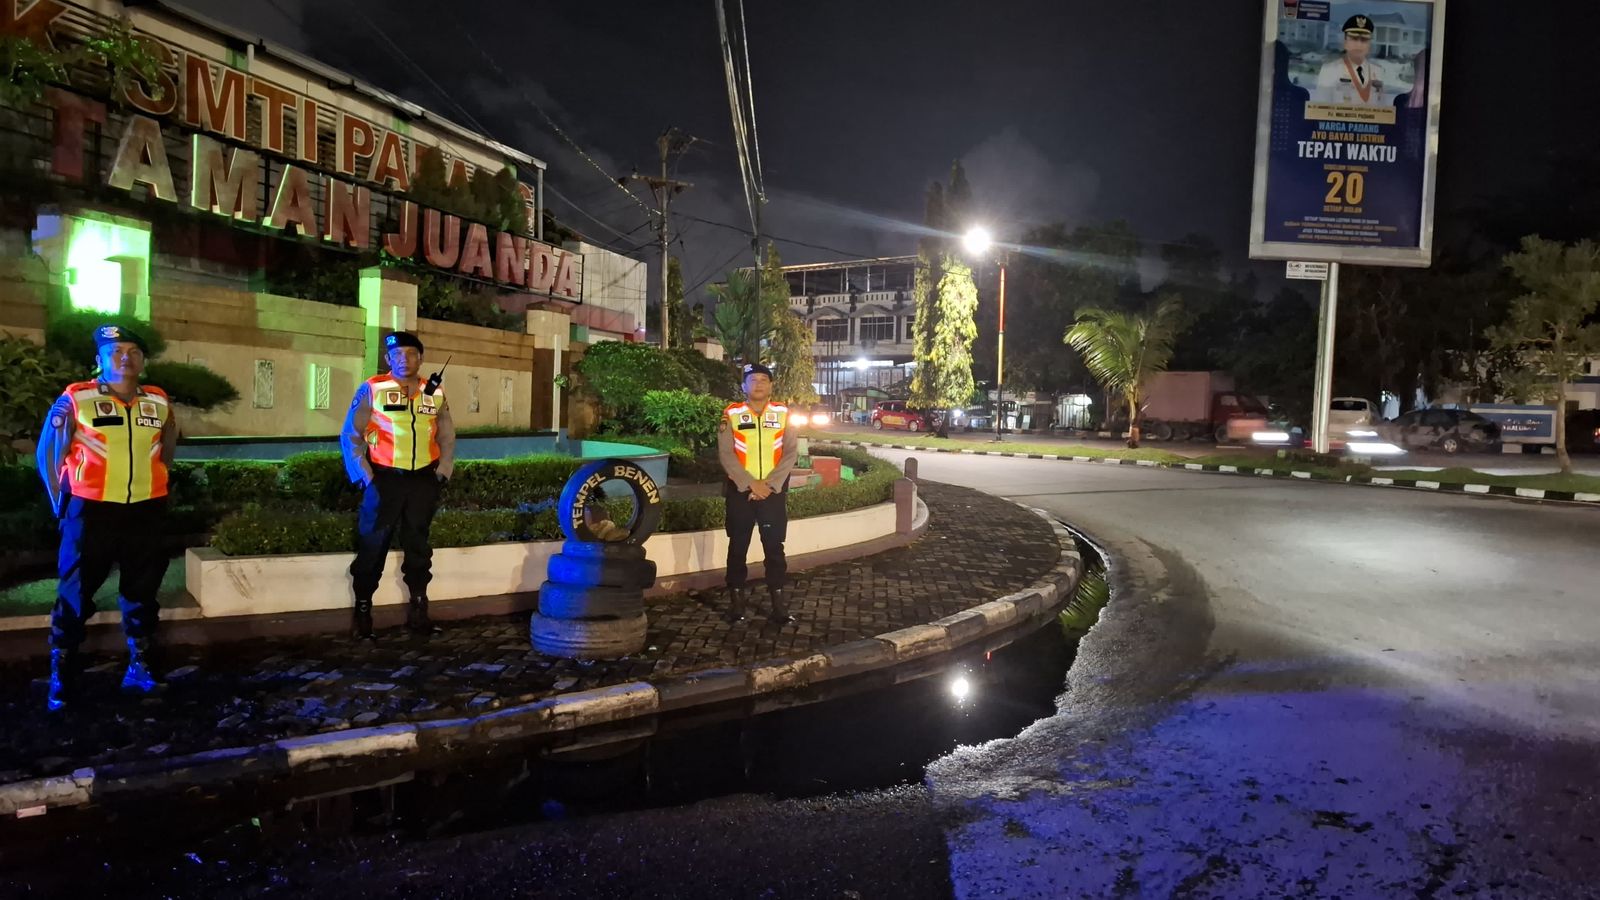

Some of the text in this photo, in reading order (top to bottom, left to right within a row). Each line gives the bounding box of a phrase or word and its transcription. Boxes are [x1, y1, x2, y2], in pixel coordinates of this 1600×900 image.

[1311, 131, 1386, 144] AYO BAYAR LISTRIK
[1319, 121, 1379, 133] WARGA PADANG
[1297, 141, 1397, 162] TEPAT WAKTU
[45, 86, 578, 298] TAMAN JUANDA
[1325, 172, 1364, 205] 20
[573, 465, 660, 529] TEMPEL BENEN
